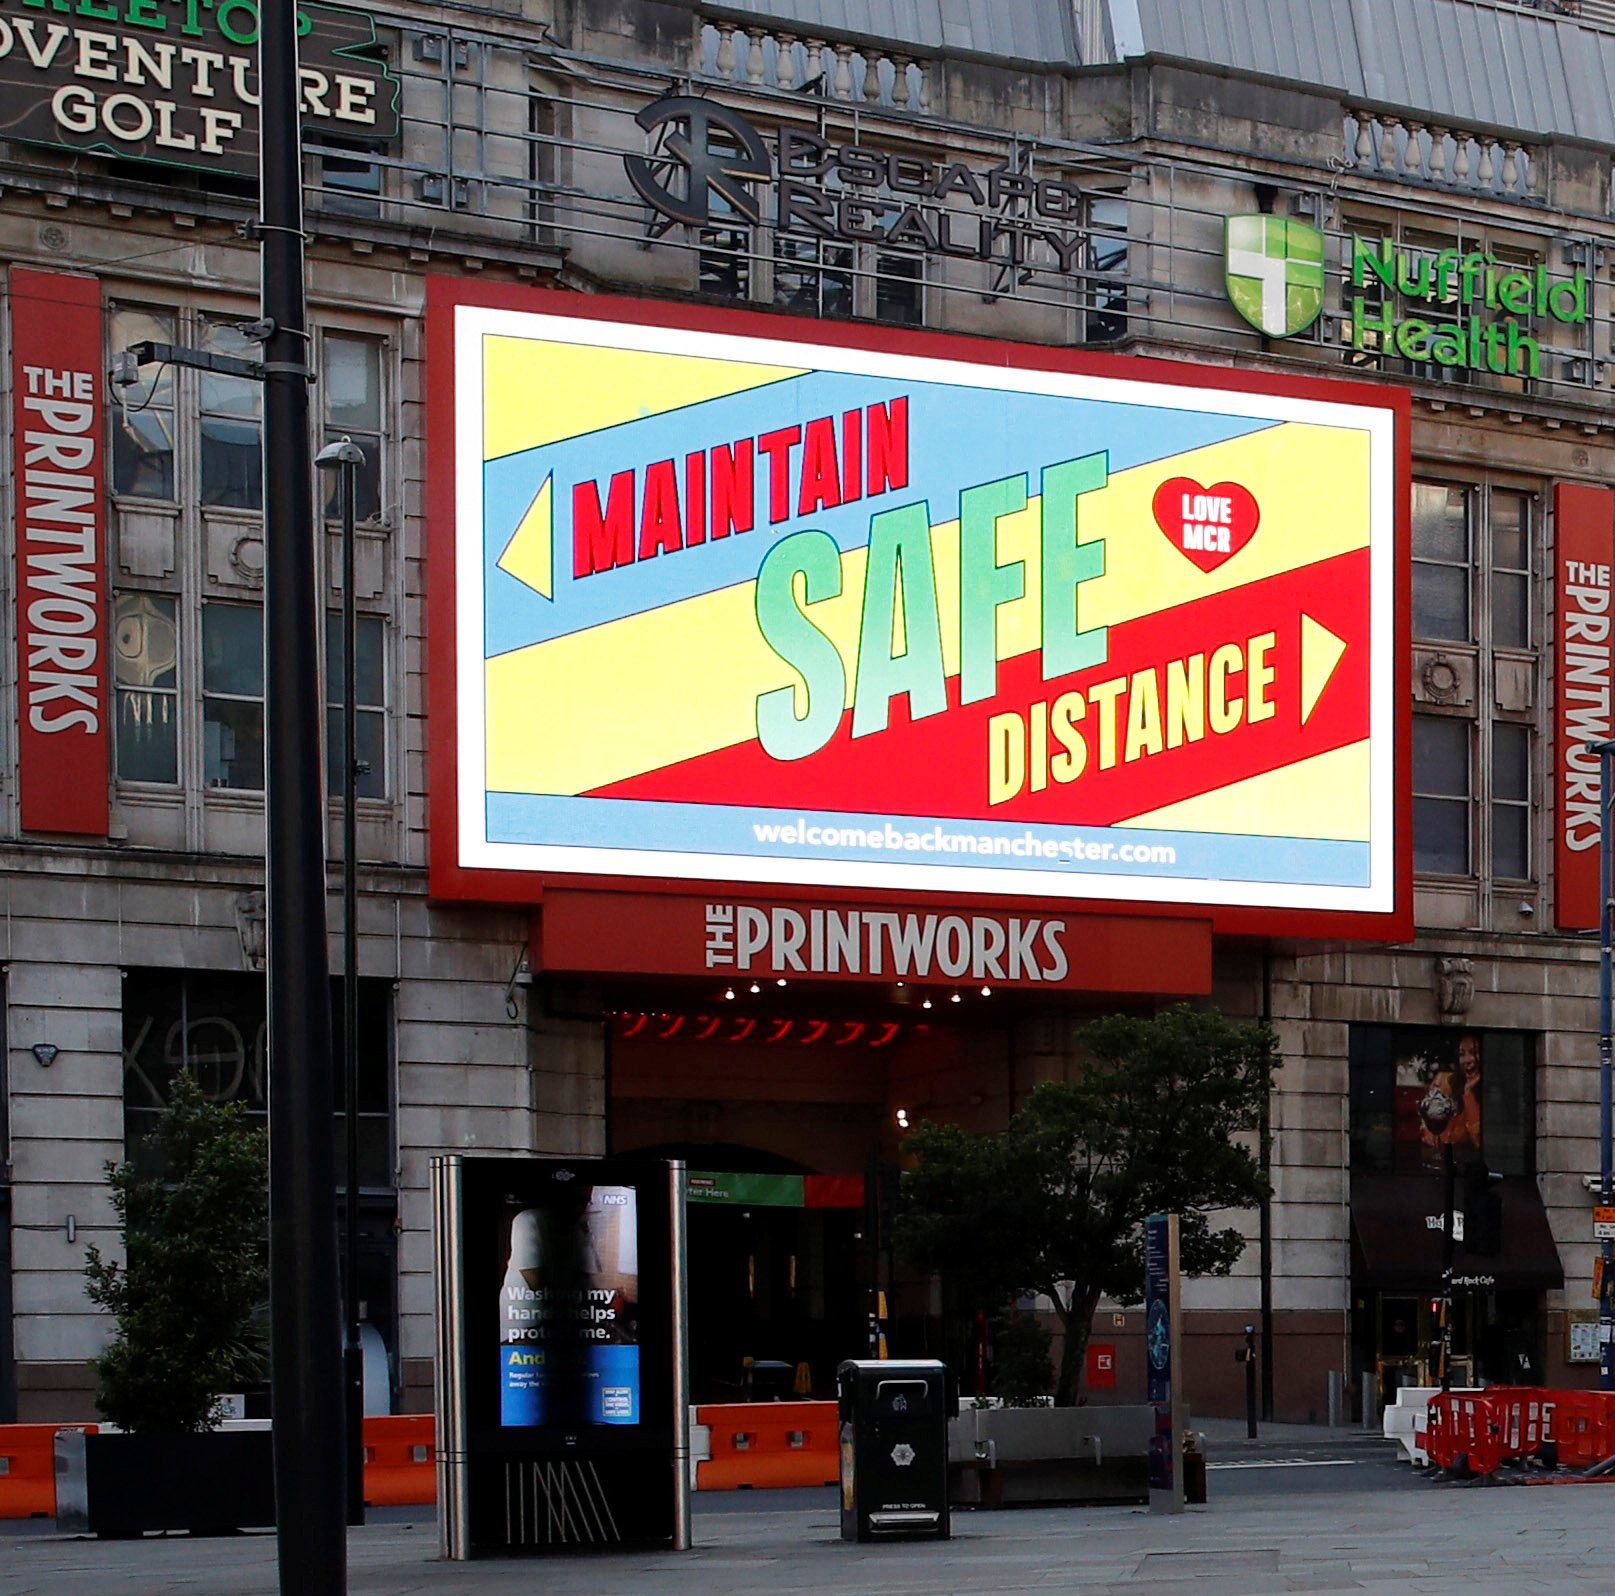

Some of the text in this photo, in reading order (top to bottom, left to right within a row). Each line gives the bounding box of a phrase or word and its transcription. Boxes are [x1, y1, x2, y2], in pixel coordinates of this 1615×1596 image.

[51, 84, 242, 155] GOLF
[778, 125, 1083, 220] ESCAPE
[778, 181, 1087, 272] REALITY
[1352, 232, 1586, 325] Nuffield
[1353, 297, 1542, 379] Health
[23, 364, 95, 400] THE
[572, 395, 910, 581] MAINTAIN
[1181, 493, 1232, 525] LOVE
[22, 396, 99, 736] PRINTWORKS
[1182, 522, 1232, 554] MCR
[1565, 559, 1611, 586] THE
[755, 449, 1109, 763] SAFE
[987, 631, 1277, 807] DISTANCE
[1565, 583, 1611, 852] PRINTWORKS
[753, 818, 1176, 865] welcomebackmanchester.com
[705, 904, 1070, 982] THE PRINTWORKS
[604, 1195, 627, 1205] NHS
[588, 1289, 616, 1304] my
[509, 1351, 546, 1366] And
